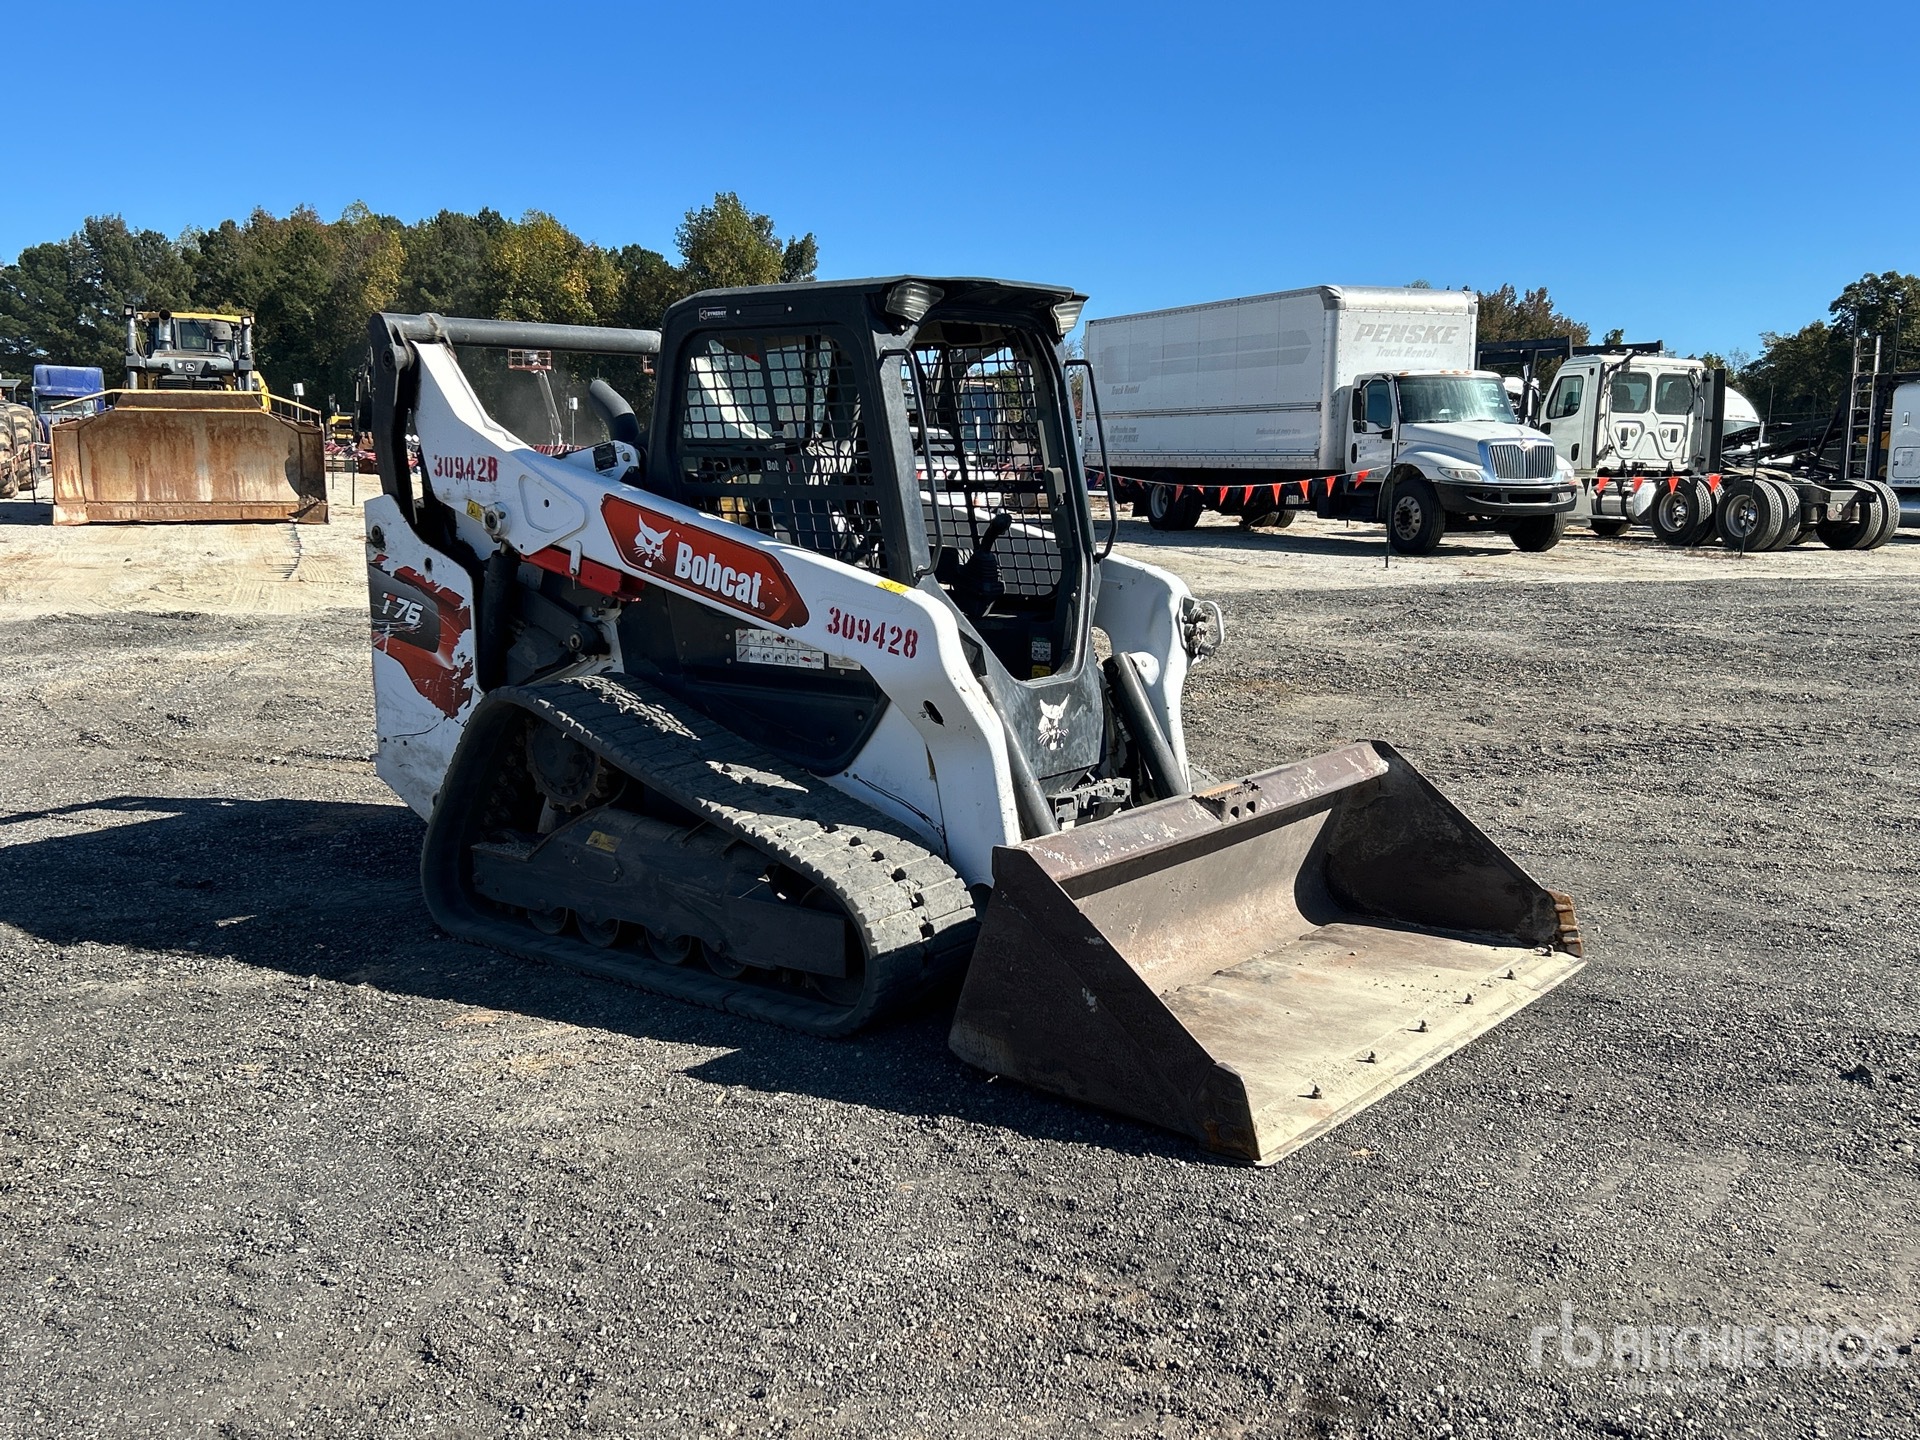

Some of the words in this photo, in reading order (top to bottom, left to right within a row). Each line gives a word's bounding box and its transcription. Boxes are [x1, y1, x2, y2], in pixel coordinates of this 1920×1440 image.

[1353, 323, 1459, 344] PENSKE
[1376, 346, 1402, 357] Truck
[1404, 346, 1438, 358] Rental
[434, 455, 498, 482] 309428
[675, 541, 762, 608] Bobcat
[382, 592, 424, 626] T76
[827, 607, 918, 658] 309428
